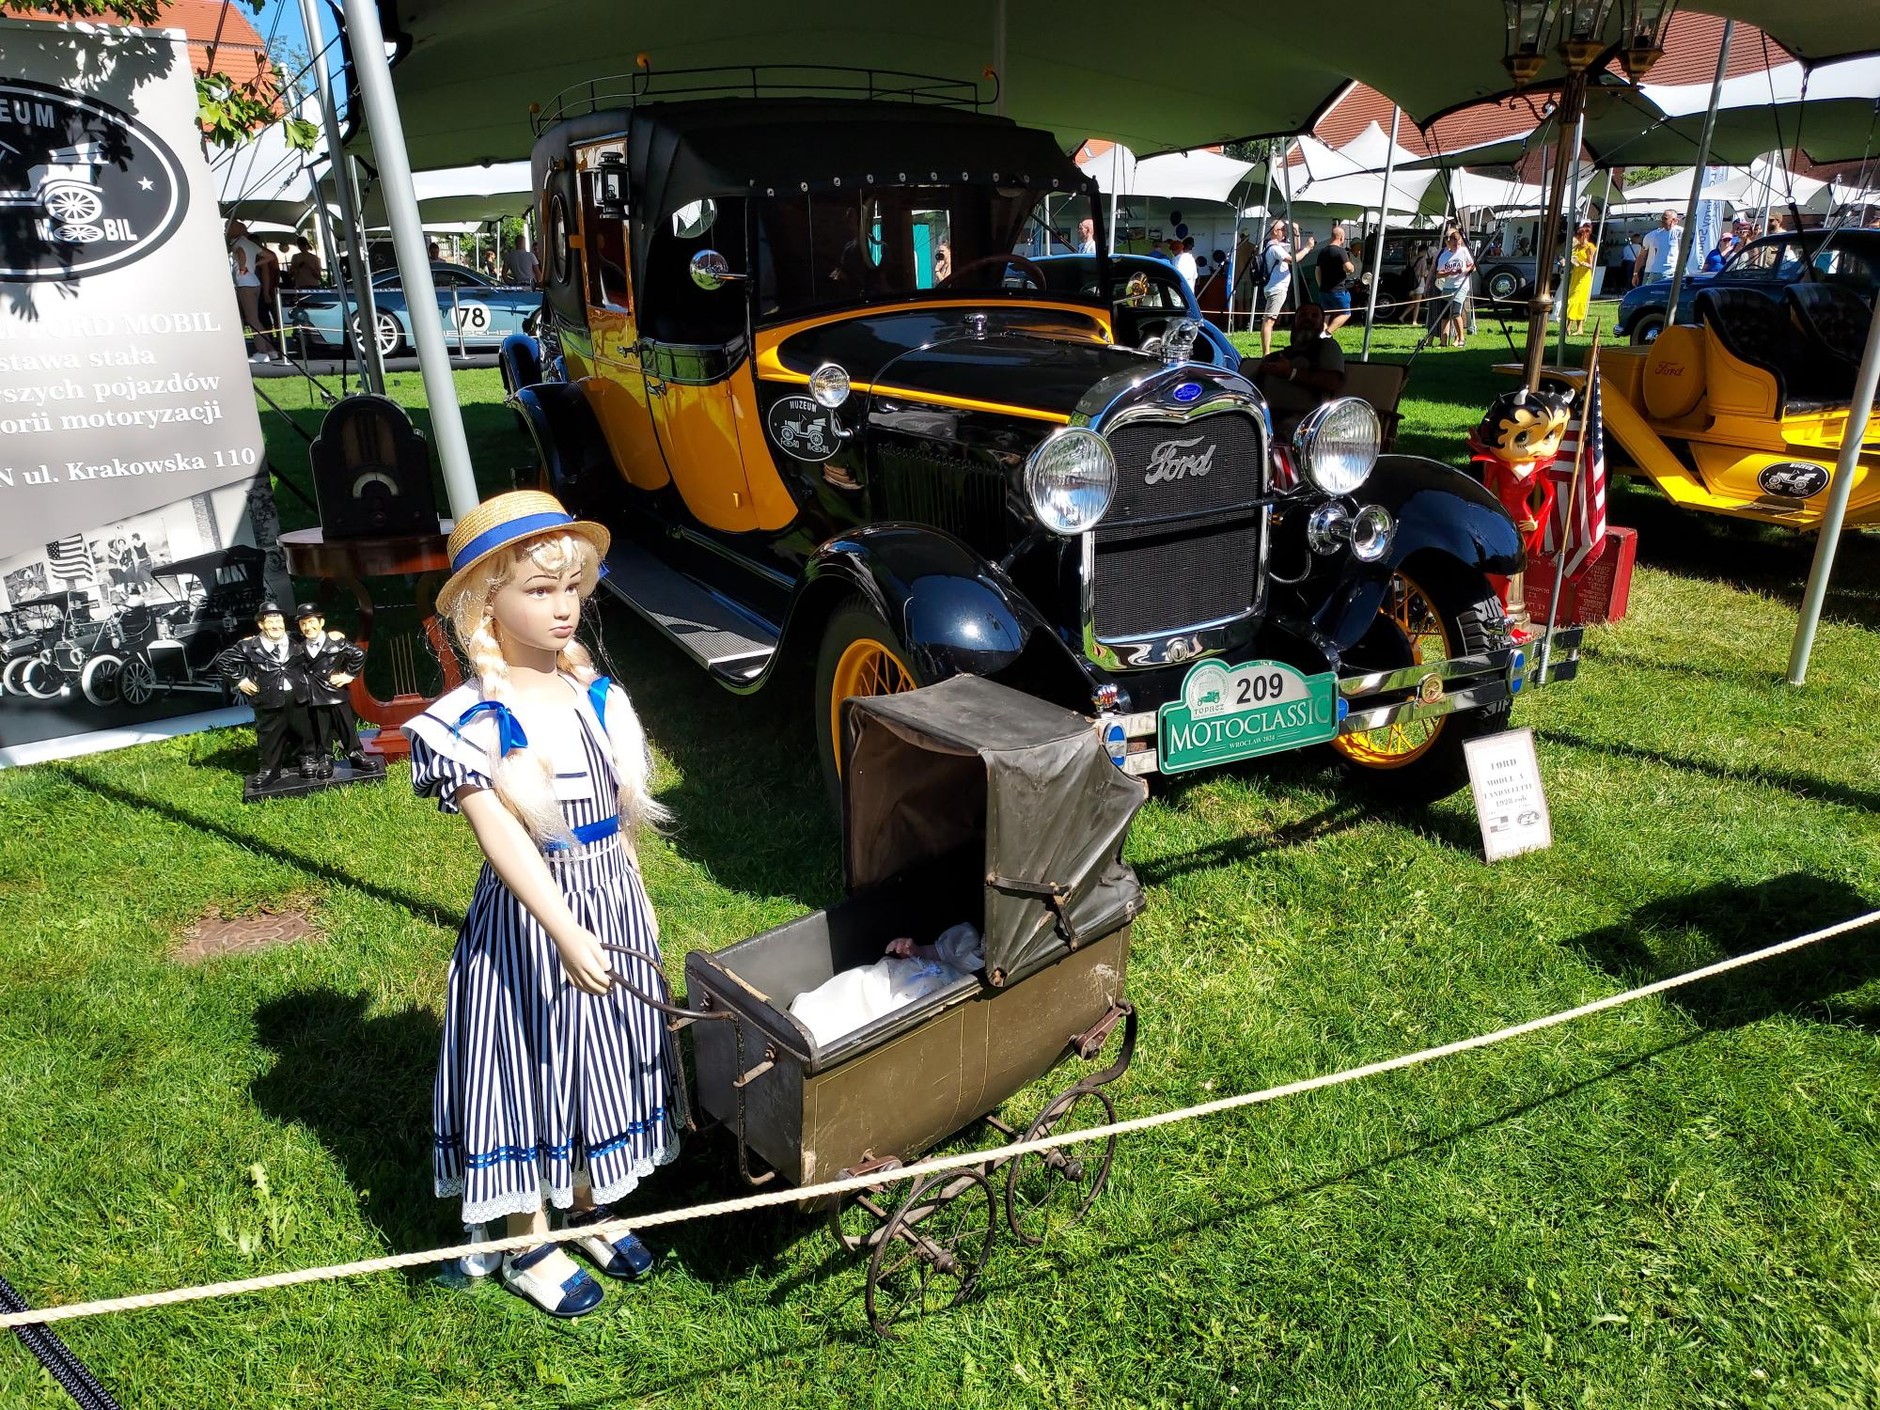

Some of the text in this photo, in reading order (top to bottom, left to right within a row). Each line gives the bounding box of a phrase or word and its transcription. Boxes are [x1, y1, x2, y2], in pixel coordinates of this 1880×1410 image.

[125, 312, 221, 333] MOBIL
[458, 307, 486, 328] 78
[1655, 361, 1686, 377] Ford
[93, 372, 220, 402] pojazdów
[61, 401, 222, 430] motoryzacji
[790, 400, 817, 413] MUZEUM
[22, 464, 59, 485] ul.
[65, 453, 207, 481] Krakowska
[215, 448, 256, 468] 110
[1144, 435, 1217, 485] Ford
[1236, 673, 1284, 705] 209
[1169, 694, 1331, 755] MOTOCLASSIC
